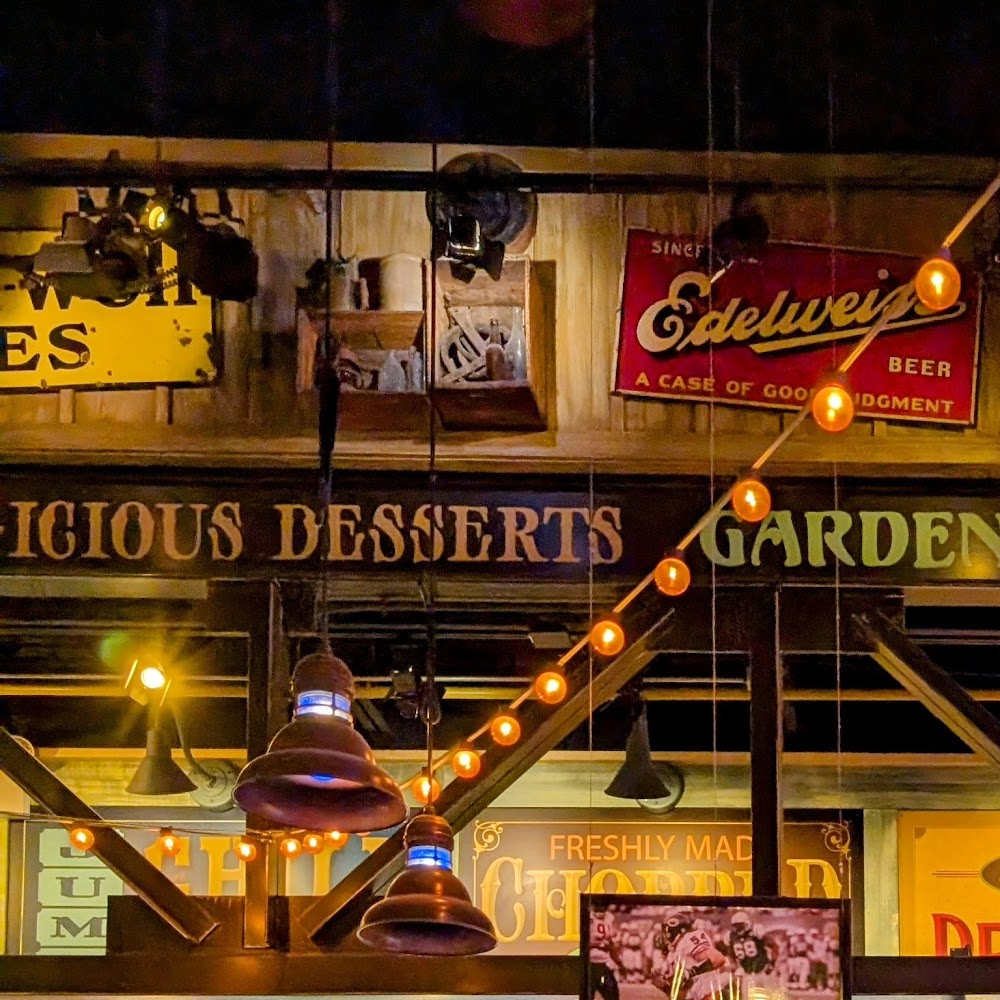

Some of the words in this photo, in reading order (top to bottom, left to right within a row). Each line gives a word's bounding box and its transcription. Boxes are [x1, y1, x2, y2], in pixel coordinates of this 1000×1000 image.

[636, 268, 966, 354] Edelwei
[888, 356, 952, 378] BEER
[635, 371, 650, 387] A
[658, 374, 715, 392] CASE
[726, 380, 754, 396] OF
[0, 500, 243, 561] ICIOUS
[272, 502, 624, 565] DESSERTS
[549, 833, 676, 862] FRESHLY
[686, 834, 753, 862] MAD
